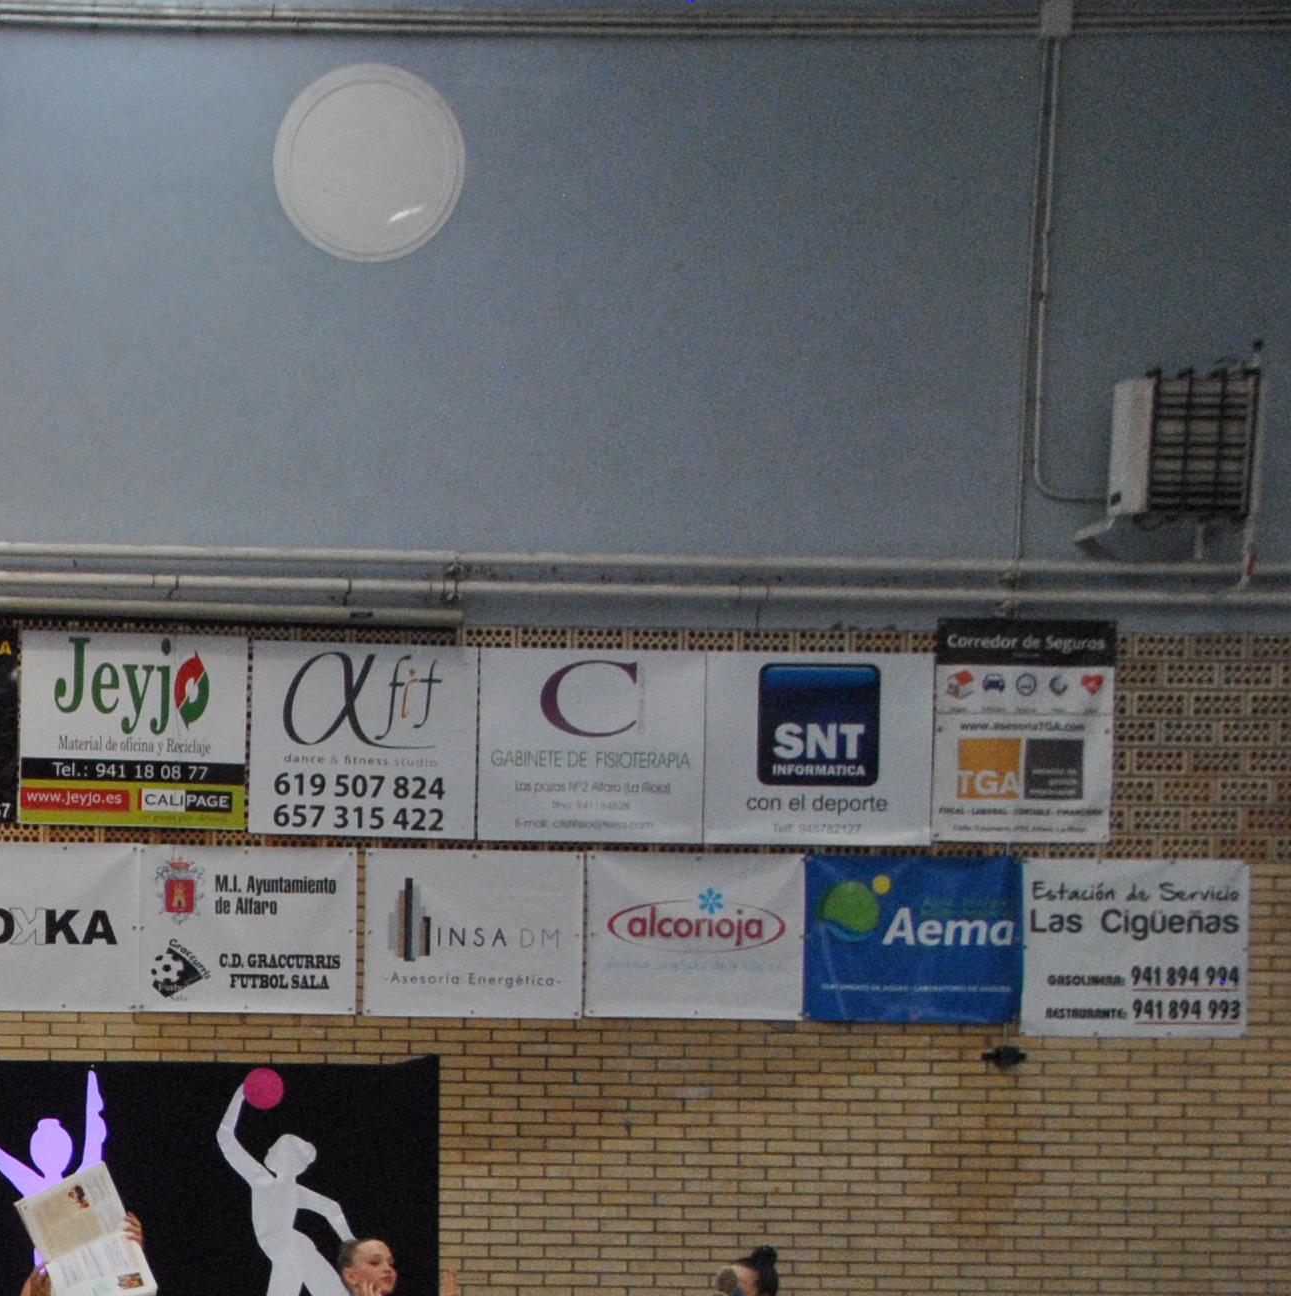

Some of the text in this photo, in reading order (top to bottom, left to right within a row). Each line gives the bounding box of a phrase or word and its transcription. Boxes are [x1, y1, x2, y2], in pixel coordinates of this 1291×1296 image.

[947, 633, 1106, 654] Corredor de Seguros
[57, 735, 212, 758] Material de oficina y Reciclaje
[773, 722, 865, 759] SNT
[52, 761, 209, 781] Tel.: 941 18 08 77
[283, 753, 326, 764] dance
[344, 755, 390, 766] fitness
[394, 756, 439, 768] studio
[490, 750, 692, 770] GABINETE DE FISIOTERAPIA
[772, 764, 866, 777] INFORMATICA
[274, 772, 445, 801] 619 507 824
[958, 770, 1021, 795] TGA
[26, 791, 124, 807] www.jeyjo.es
[746, 795, 888, 815] con el deporte
[273, 804, 444, 832] 657 315 422
[214, 875, 337, 897] M.I. Ayuntamiento
[1032, 880, 1239, 902] Estación de Servicio
[215, 896, 278, 915] de Alfaro
[882, 907, 1015, 946] Aema
[1030, 907, 1240, 941] Las Cigüeñas
[437, 926, 507, 948] INSA
[219, 953, 341, 969] C.D. GRACCURRIS
[229, 973, 330, 990] FUTBOL SALA
[1131, 965, 1162, 987] 941
[1166, 966, 1200, 987] 894
[1206, 966, 1240, 987] 994
[1132, 998, 1163, 1020] 941
[1168, 998, 1202, 1020] 894
[1208, 999, 1241, 1020] 993
